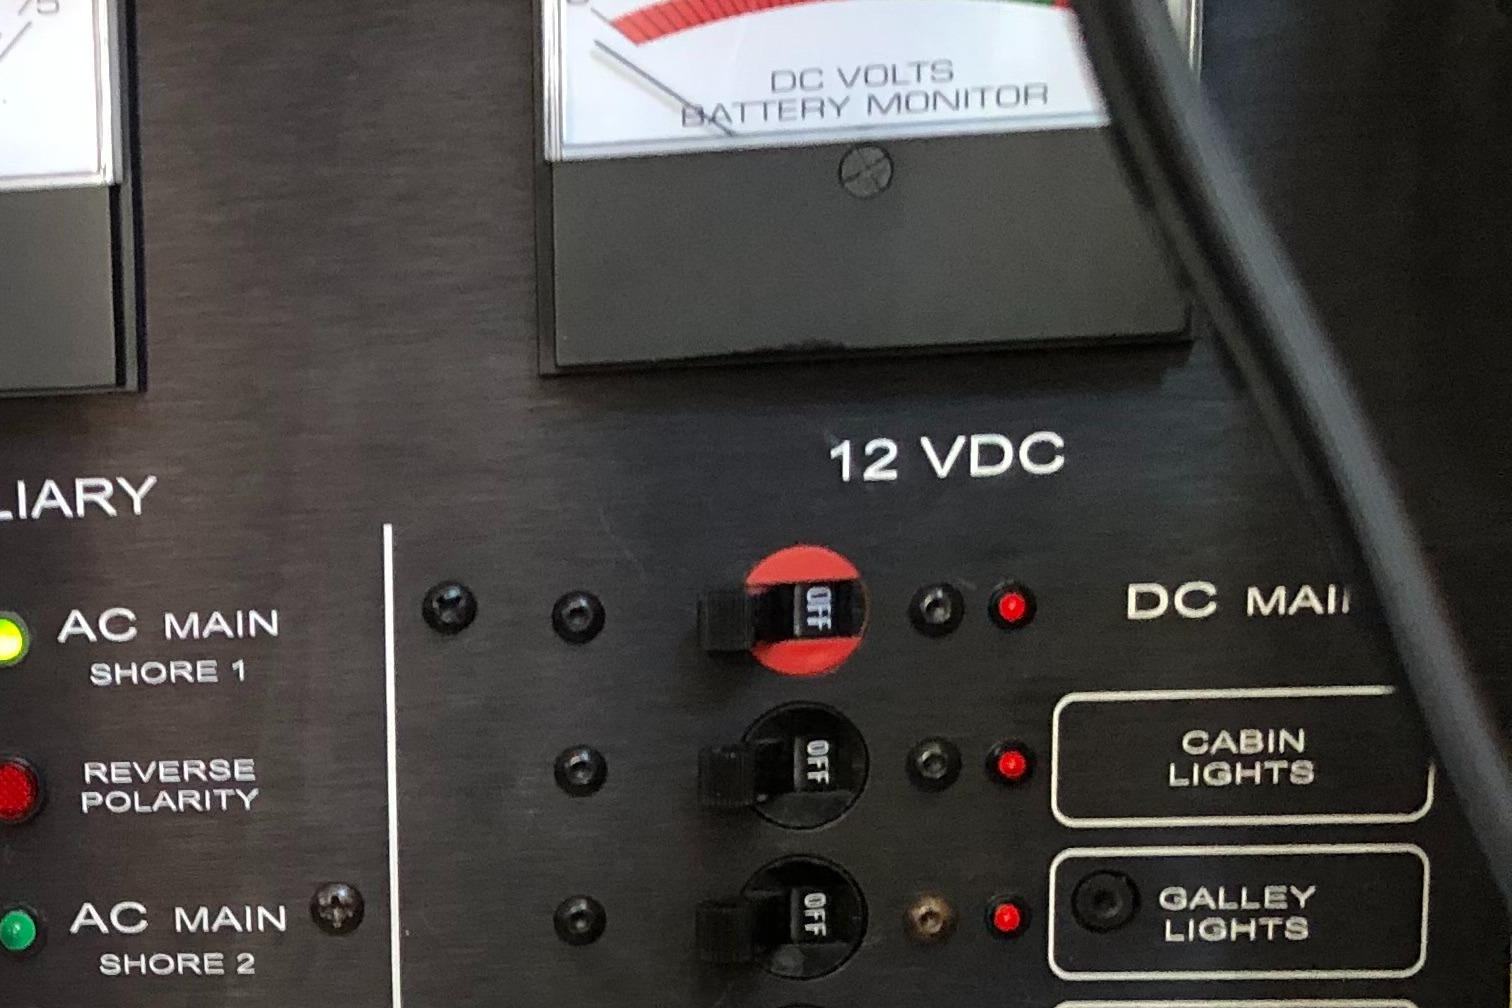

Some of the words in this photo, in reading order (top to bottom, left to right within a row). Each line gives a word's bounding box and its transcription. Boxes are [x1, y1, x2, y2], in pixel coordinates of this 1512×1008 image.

[770, 68, 825, 93] DC
[838, 59, 954, 88] VOLTS
[681, 96, 851, 129] BATTERY
[867, 83, 1049, 116] MONITOR
[830, 437, 898, 482] 12
[920, 431, 1065, 479] VDC
[806, 586, 832, 631] OFF
[1127, 580, 1217, 620] DC
[57, 607, 138, 643] AC
[164, 609, 279, 640] MAIN
[89, 659, 219, 686] SHORE
[232, 659, 245, 682] 1
[1182, 728, 1305, 755] CABIN
[84, 758, 256, 784] REVERSE
[806, 739, 830, 784] OFF
[1169, 759, 1315, 787] LIGHTS
[81, 787, 259, 814] POLARITY
[803, 892, 827, 937] OFF
[1158, 885, 1316, 911] GALLEY
[69, 901, 149, 934] AC
[174, 905, 286, 933] MAIN
[1165, 916, 1309, 942] LIGHTS
[99, 952, 225, 976] SHORE
[236, 952, 255, 975] 2
